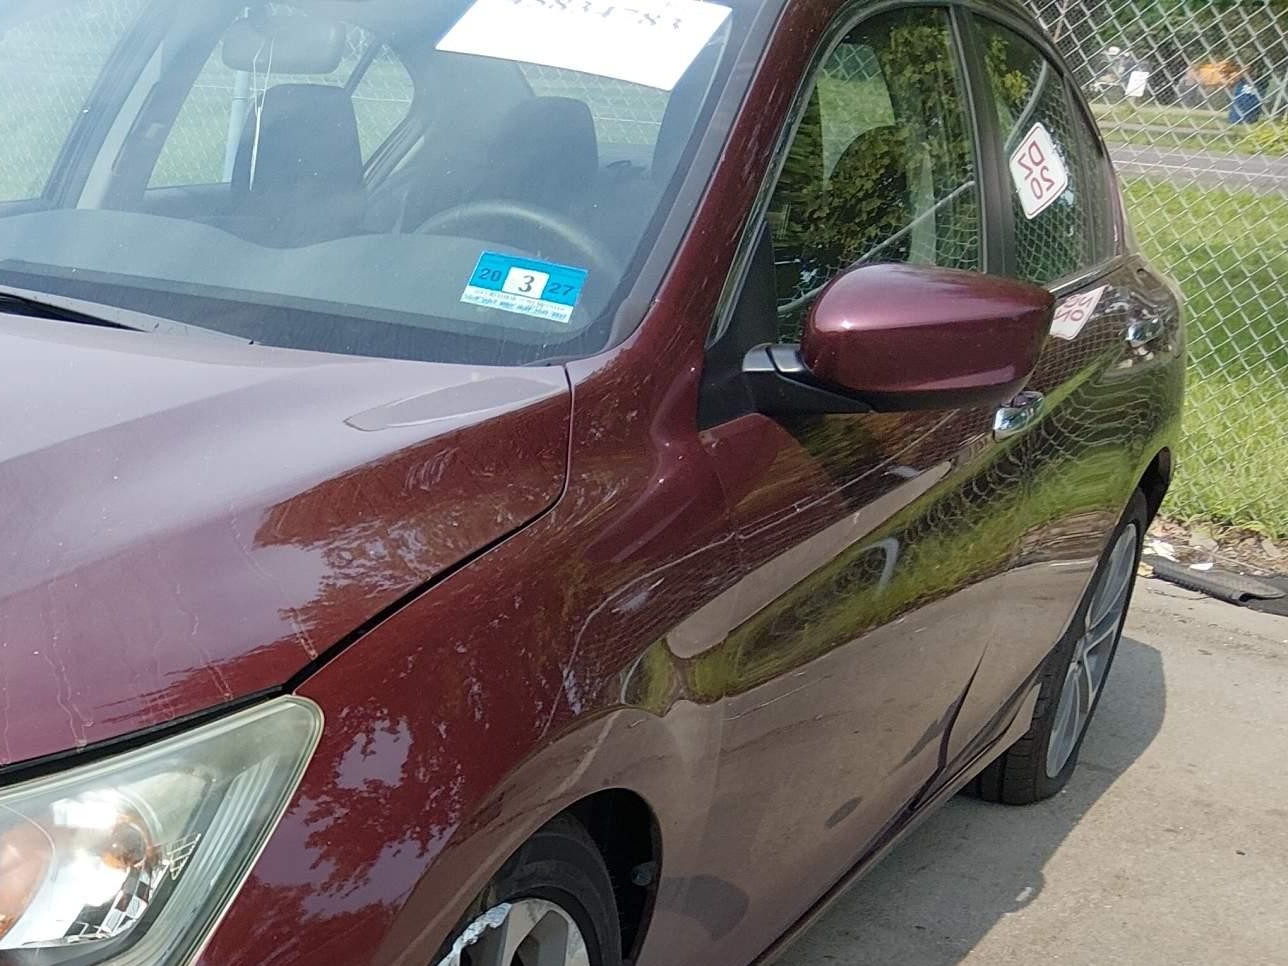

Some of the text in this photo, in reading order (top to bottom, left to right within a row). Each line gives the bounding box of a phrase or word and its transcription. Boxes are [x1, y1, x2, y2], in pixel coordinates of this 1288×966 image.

[478, 267, 576, 297] 20 3 27
